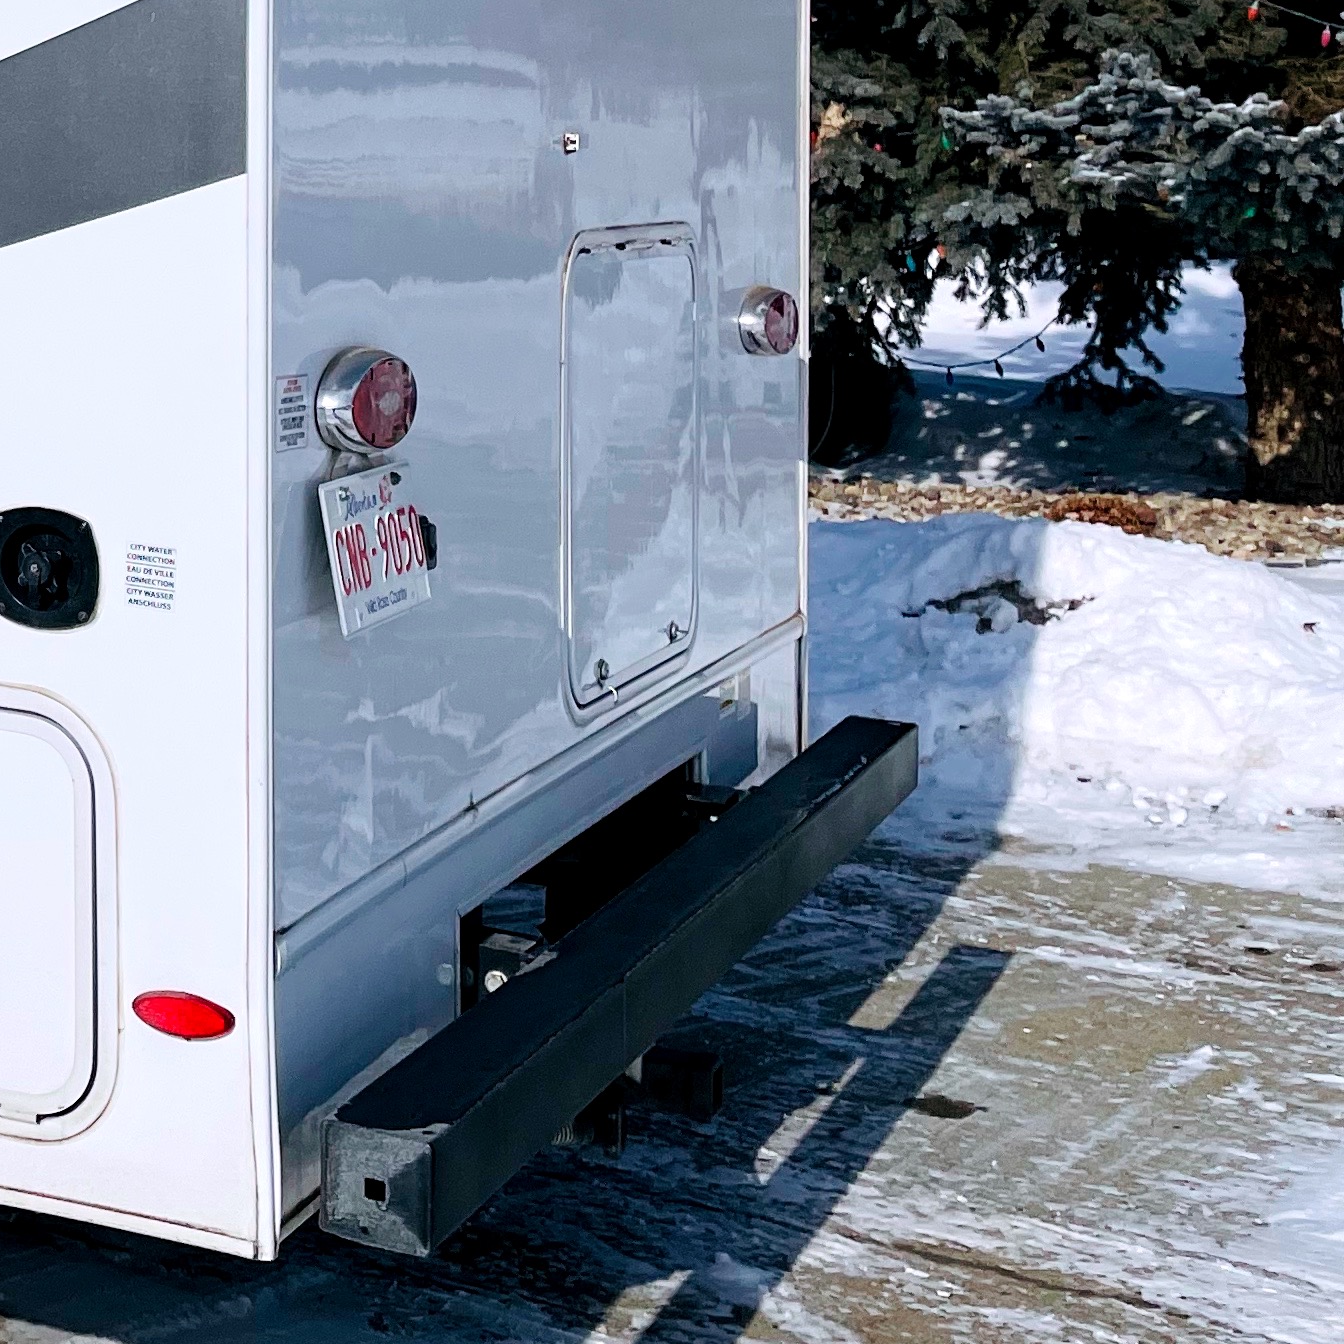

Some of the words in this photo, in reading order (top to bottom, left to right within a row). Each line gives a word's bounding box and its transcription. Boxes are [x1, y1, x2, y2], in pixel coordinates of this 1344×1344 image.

[148, 546, 173, 555] WATER
[127, 553, 175, 565] CONNECTION
[127, 565, 141, 573] EAU
[154, 569, 174, 578] VILLE
[126, 576, 174, 588] CONNECTION
[144, 591, 174, 600] WASSER
